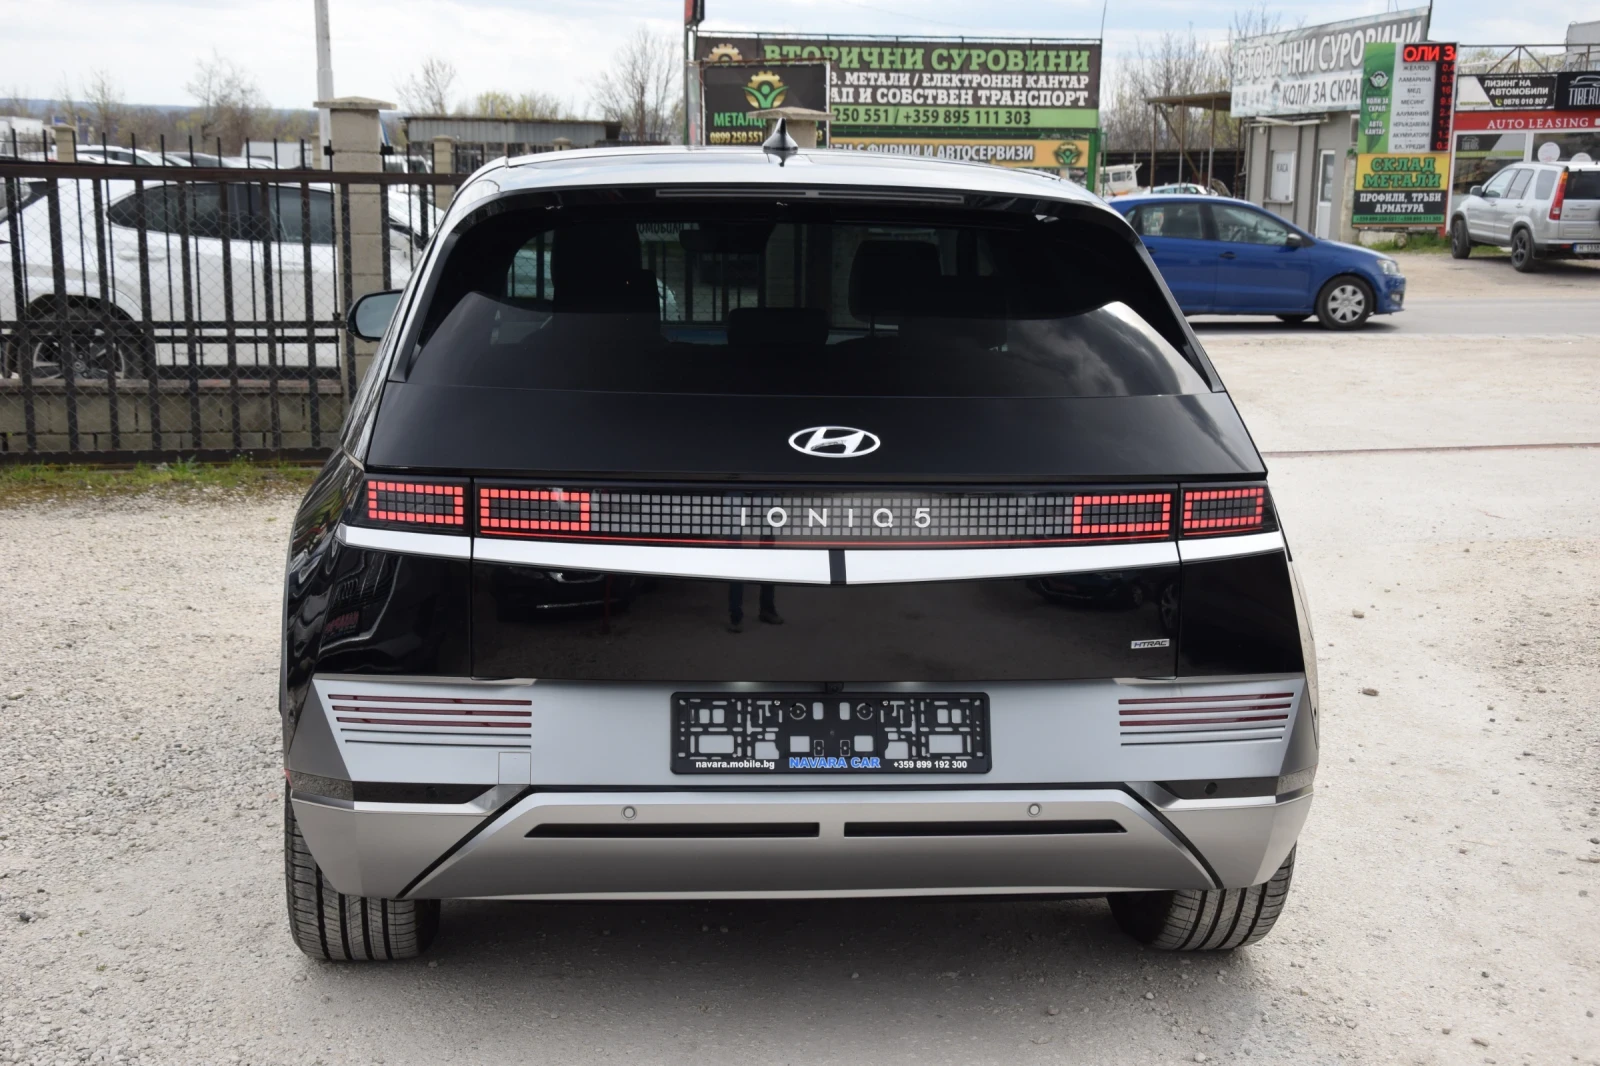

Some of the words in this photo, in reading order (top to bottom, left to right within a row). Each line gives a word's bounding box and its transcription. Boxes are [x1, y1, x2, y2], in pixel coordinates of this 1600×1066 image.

[764, 45, 925, 70] ВТОРИЧНИ
[931, 48, 1090, 72] СУРОВИНИ
[1237, 38, 1316, 80] ВТОРИЧНИ
[1443, 45, 1456, 61] З
[845, 72, 910, 87] МЕТАЛИ
[922, 73, 1023, 88] ЕЛЕКТРОНЕН
[1026, 75, 1089, 89] КАНТАР
[859, 88, 874, 103] И
[877, 88, 973, 105] СОБСТВЕН
[978, 89, 1088, 106] ТРАНСПОРТ
[1282, 82, 1311, 106] КОЛИ
[1312, 81, 1326, 103] ЗА
[1489, 87, 1548, 95] АВТОМОБИЛИ
[833, 108, 859, 123] 250
[864, 108, 888, 123] 551
[904, 109, 939, 124] +359
[944, 110, 969, 124] 895
[975, 111, 1000, 125] 111
[1005, 111, 1031, 125] 303
[1487, 119, 1524, 129] AUTO
[1528, 117, 1589, 128] LEASING
[710, 131, 731, 144] 0899
[732, 131, 747, 143] 250
[748, 131, 763, 143] 551
[924, 145, 933, 157] И
[937, 144, 1034, 161] АВТОСЕРВИЗИ
[1371, 157, 1436, 173] СКЛАД
[1363, 173, 1441, 188] МЕТАЛИ
[1360, 192, 1407, 203] ПРОФИЛИ,
[1412, 192, 1442, 202] ТРЪБИ
[1375, 203, 1424, 213] АРМАТУРА
[740, 506, 893, 528] IONIQ
[914, 507, 931, 528] 5
[1133, 640, 1168, 648] HTRAC
[695, 759, 775, 770] navara.mobile.bg
[788, 757, 847, 769] NAVARA
[851, 757, 881, 768] CAR
[893, 760, 914, 769] +359
[916, 760, 932, 769] 899
[934, 760, 949, 769] 192
[952, 760, 968, 769] 300
